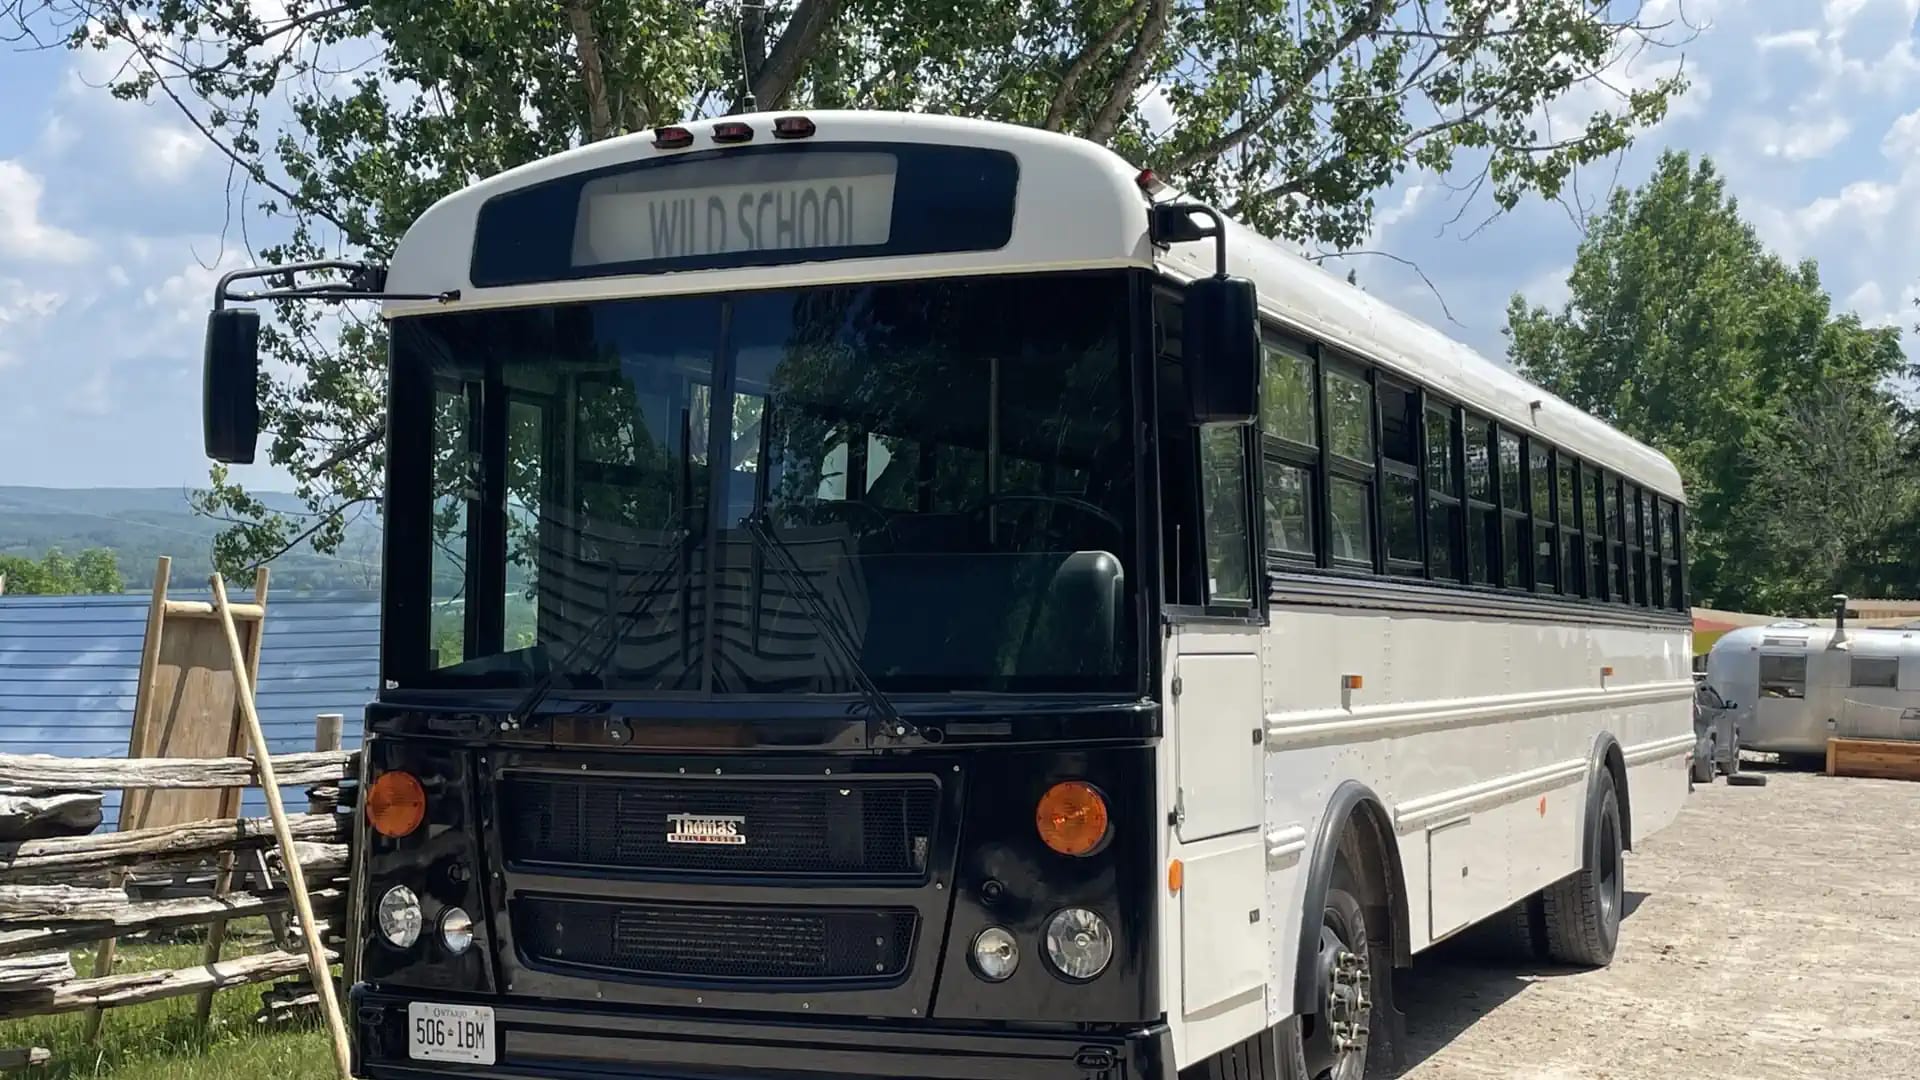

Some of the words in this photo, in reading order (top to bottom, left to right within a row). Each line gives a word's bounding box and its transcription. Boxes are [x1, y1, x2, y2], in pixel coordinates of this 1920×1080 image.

[649, 196, 727, 257] WILD
[737, 185, 854, 250] SCHOOL
[667, 812, 745, 836] Thomas
